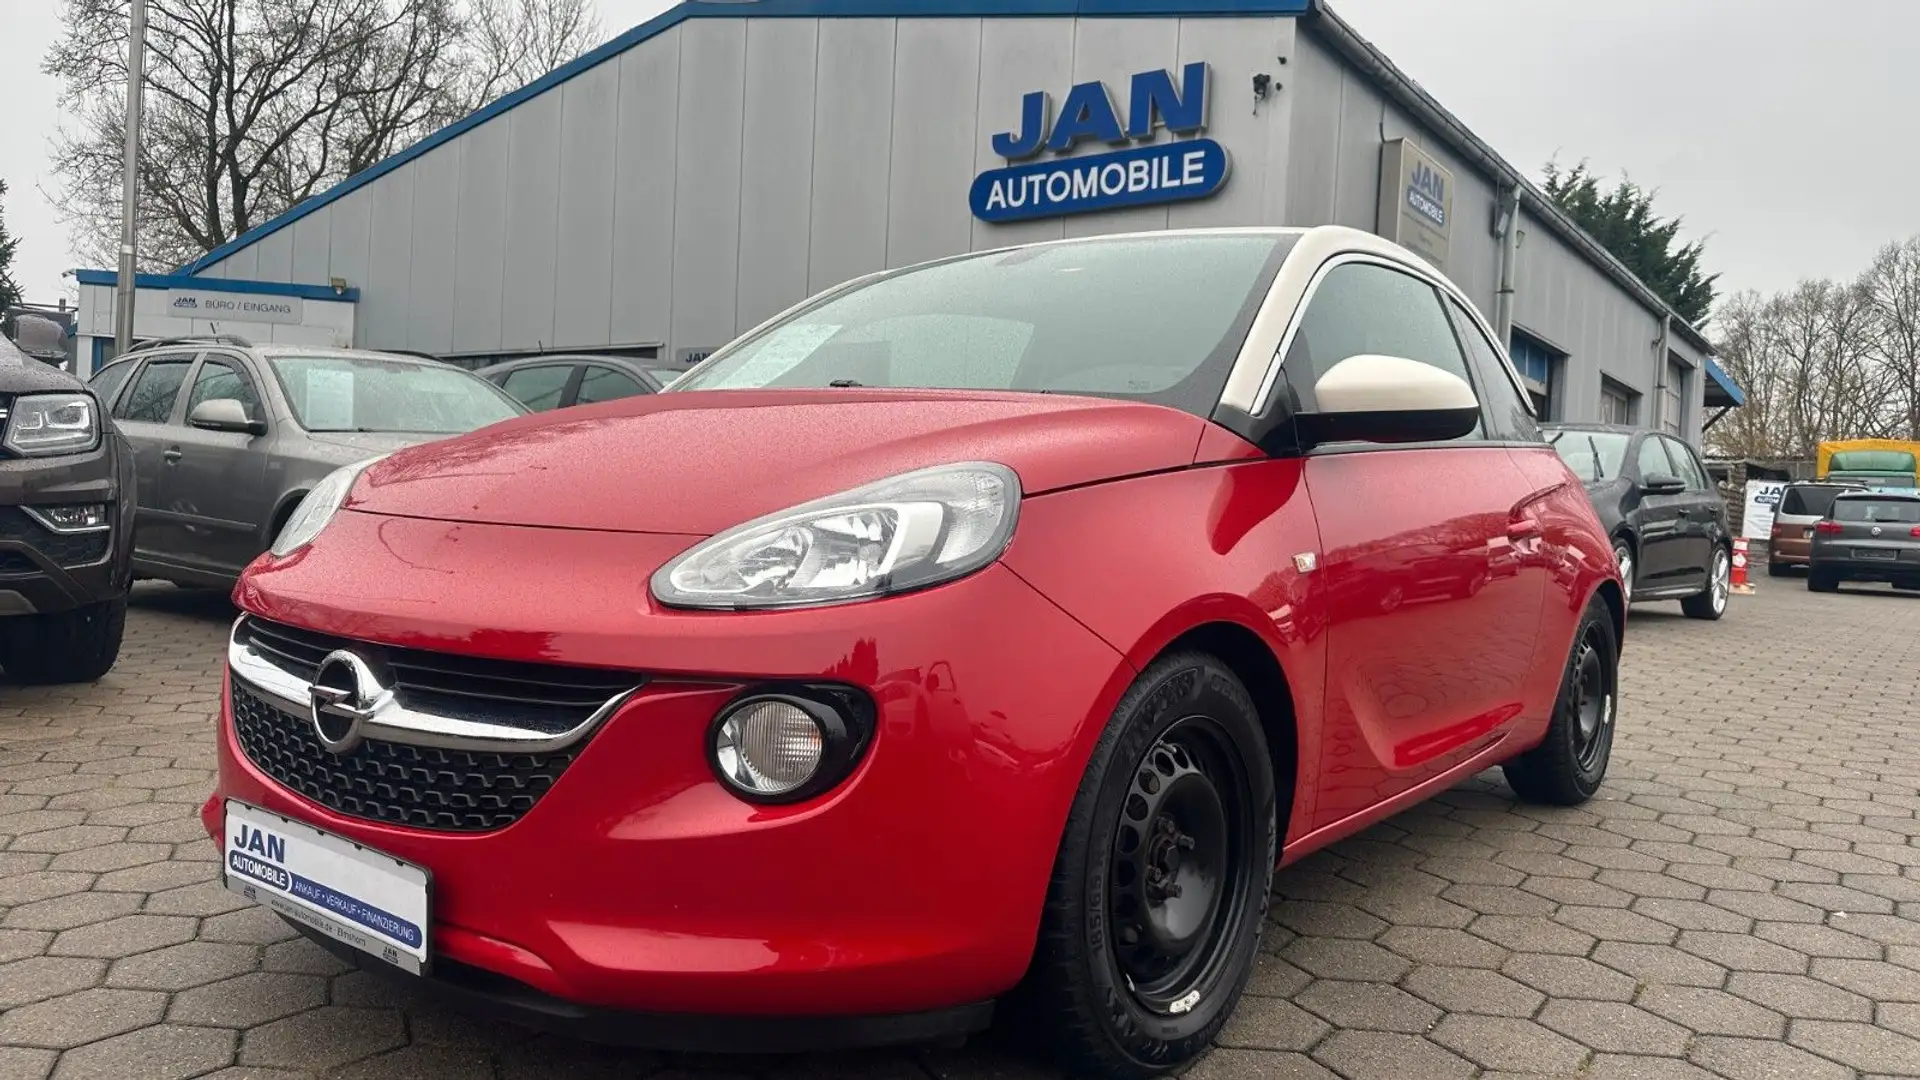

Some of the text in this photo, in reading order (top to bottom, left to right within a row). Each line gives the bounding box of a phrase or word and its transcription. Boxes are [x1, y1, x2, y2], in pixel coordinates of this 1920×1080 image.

[992, 61, 1207, 158] JAN
[986, 151, 1205, 210] AUTOMOBILE
[1411, 160, 1444, 202] JAN
[1409, 191, 1443, 224] AUTOMOBILE
[205, 299, 235, 310] BÜRO
[243, 303, 291, 314] EINGANG
[1759, 486, 1781, 495] JA
[234, 824, 285, 863] JAN
[232, 855, 286, 886] AUTOMOBILE
[295, 881, 414, 941] ANKAUF VERKAUF FINANZIERUNG
